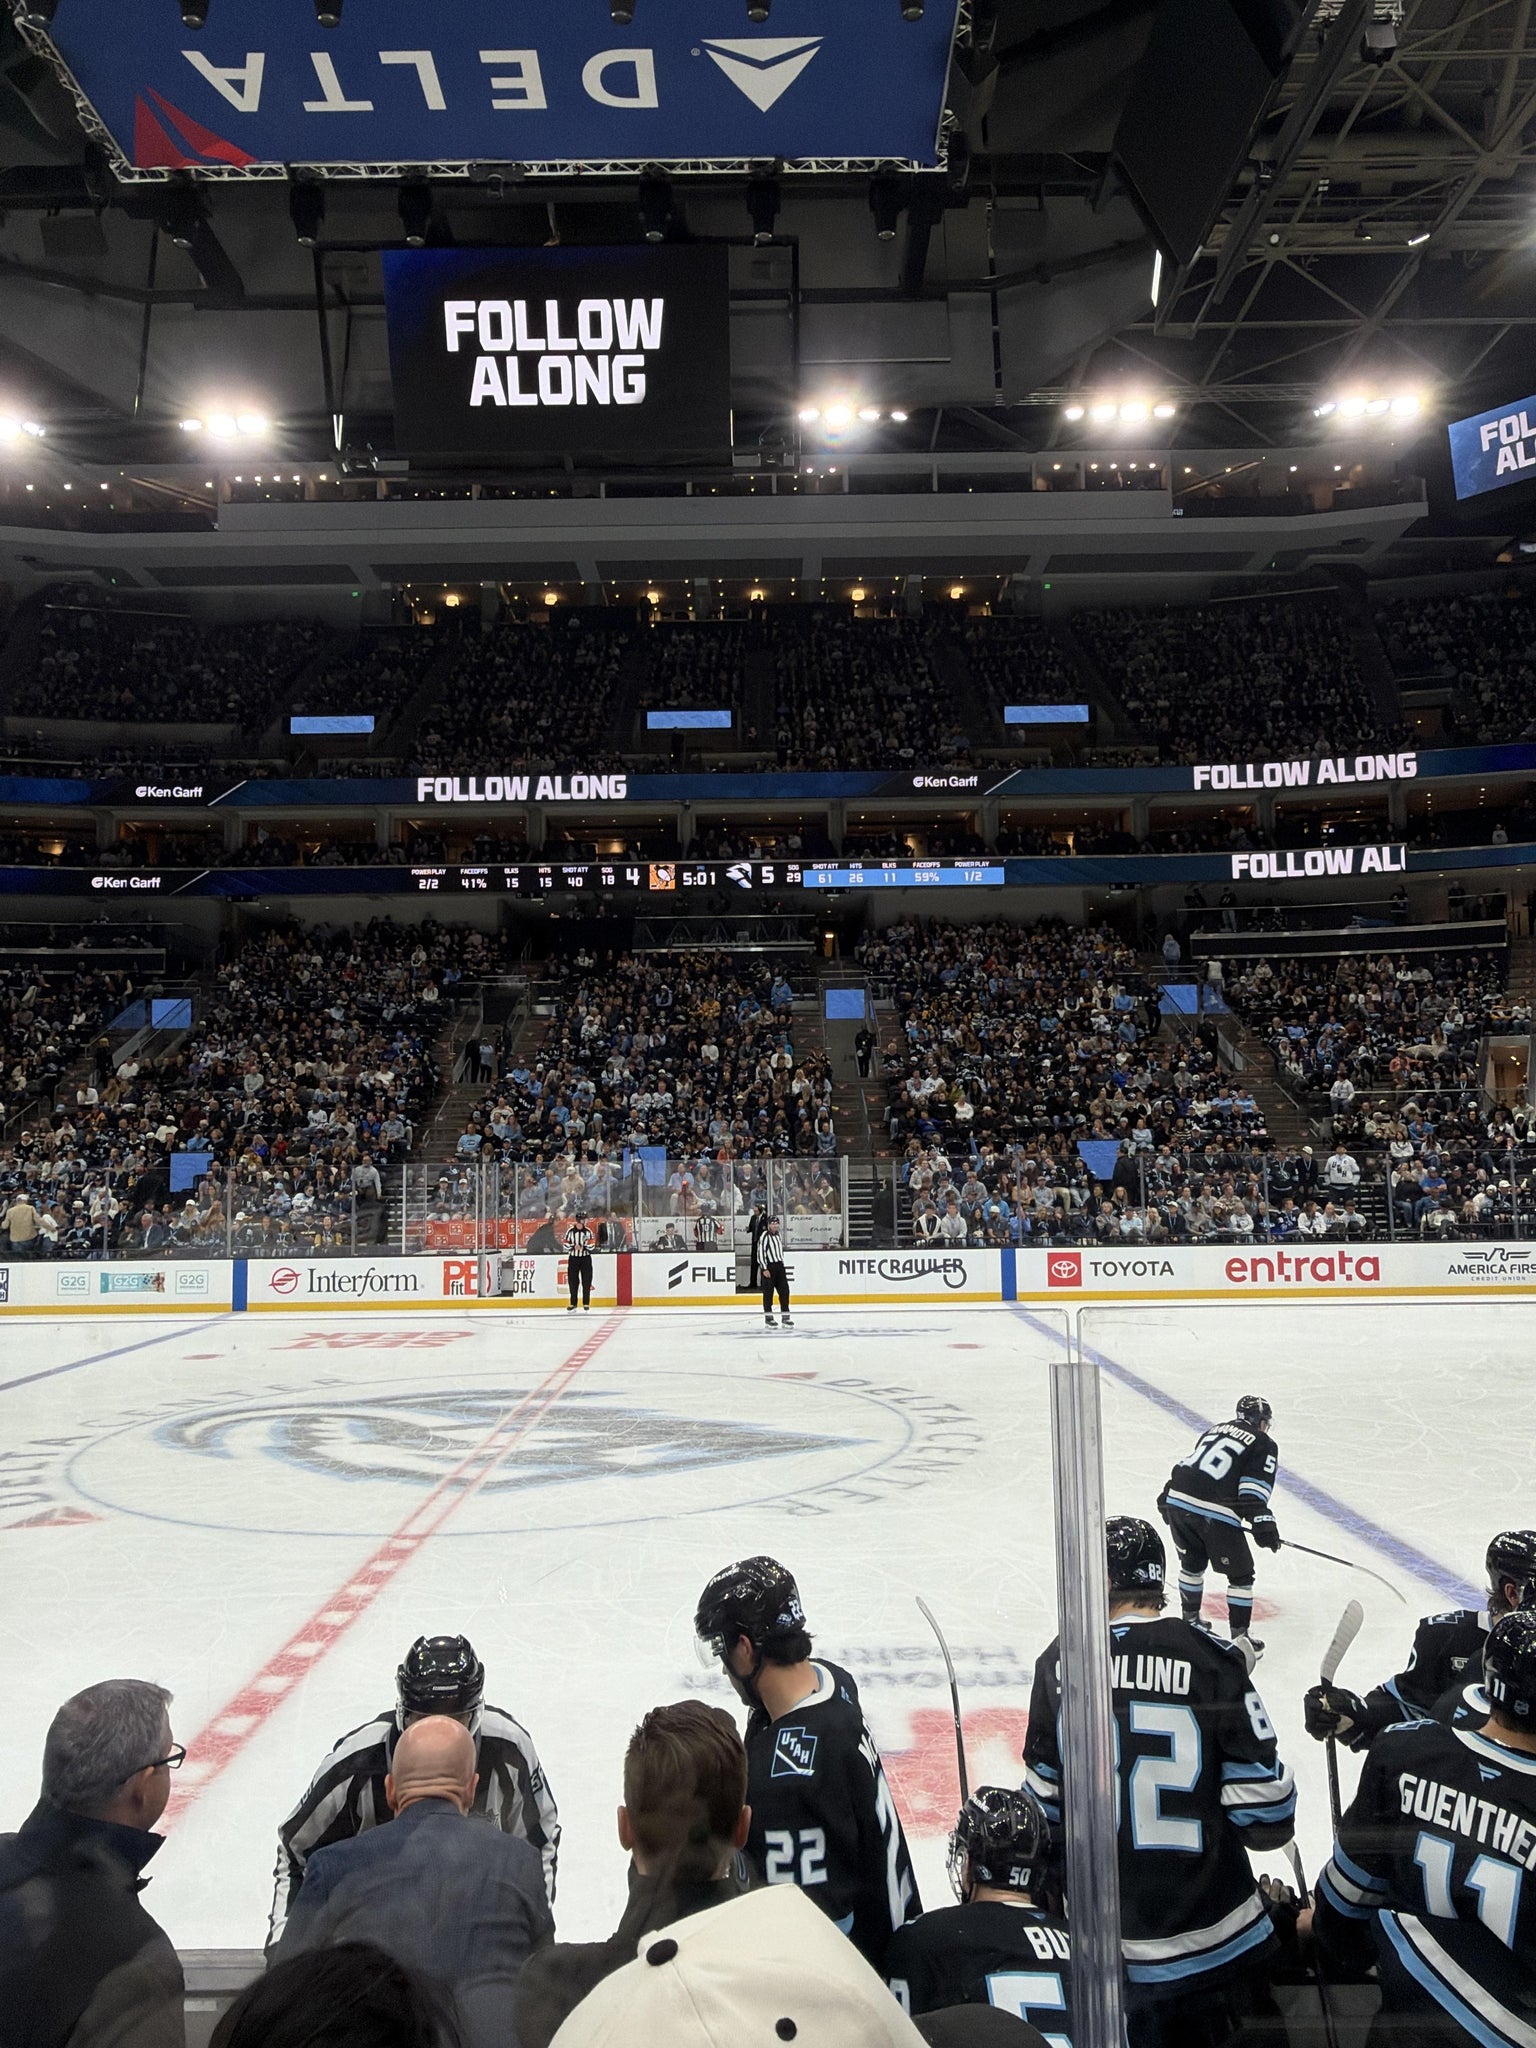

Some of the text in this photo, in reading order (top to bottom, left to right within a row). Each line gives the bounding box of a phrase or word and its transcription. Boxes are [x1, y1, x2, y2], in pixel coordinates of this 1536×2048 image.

[182, 48, 661, 112] DELTA
[444, 297, 665, 352] FOLLOW
[469, 354, 647, 407] ALONG
[1496, 440, 1536, 476] AL
[1193, 752, 1418, 792] FOLLOW ALONG
[417, 774, 627, 802] FOLLOW ALONG
[924, 774, 979, 789] Ken Garff
[147, 786, 203, 798] Ken Garff
[1231, 845, 1406, 880] FOLLOW AL
[103, 877, 161, 888] Ken Garff
[505, 877, 519, 888] 15
[539, 877, 553, 888] 15
[567, 876, 583, 888] 40
[601, 874, 615, 886] 18
[626, 868, 640, 886] 4
[682, 871, 716, 886] 5:01
[761, 866, 775, 884] 5
[786, 872, 802, 883] 29
[818, 873, 832, 884] 61
[848, 872, 864, 884] 26
[883, 872, 896, 884] 11
[914, 871, 940, 884] 59%
[964, 870, 982, 882] 1/2
[418, 878, 439, 890] 2/2
[461, 878, 487, 889] 41%
[519, 1260, 535, 1269] FOR
[1090, 1261, 1175, 1277] TOYOTA
[1225, 1250, 1380, 1283] entrata
[1447, 1264, 1508, 1275] AMERICA
[60, 1276, 86, 1287] G2G
[113, 1276, 138, 1286] G2G
[179, 1274, 205, 1285] G2G
[692, 1266, 795, 1282] FILEE
[307, 1268, 420, 1297] Interform
[451, 1280, 464, 1296] fit
[513, 1282, 535, 1294] OAL
[288, 1331, 476, 1341] GEEK
[268, 1339, 455, 1350] SEAT
[821, 1378, 977, 1425] DELTA
[1178, 1433, 1246, 1481] 56
[752, 1432, 985, 1517] CENTER
[1148, 1563, 1163, 1580] 82
[788, 1599, 803, 1621] 22
[1493, 1677, 1506, 1702] 11
[781, 1731, 810, 1764] UTAH
[765, 1827, 829, 1887] 22
[1008, 1866, 1032, 1887] 50
[1413, 1830, 1524, 1952] 11
[1023, 1926, 1072, 1961] BU
